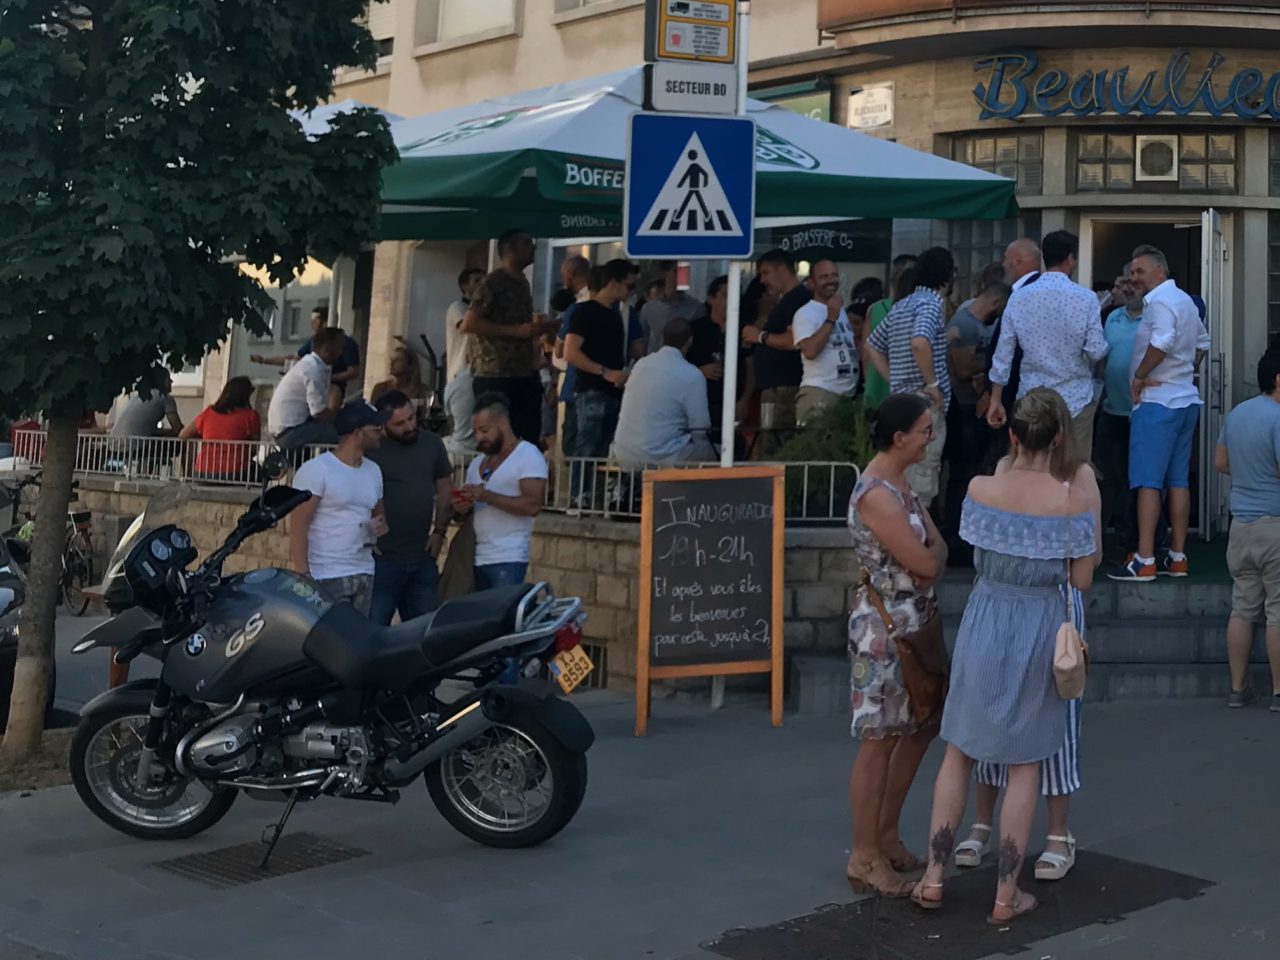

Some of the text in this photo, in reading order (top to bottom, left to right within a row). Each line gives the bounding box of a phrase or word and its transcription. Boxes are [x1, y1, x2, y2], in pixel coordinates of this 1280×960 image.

[666, 80, 710, 95] SECTEUR
[565, 163, 626, 189] BOFFE
[225, 612, 266, 659] GS
[562, 656, 590, 688] 9593
